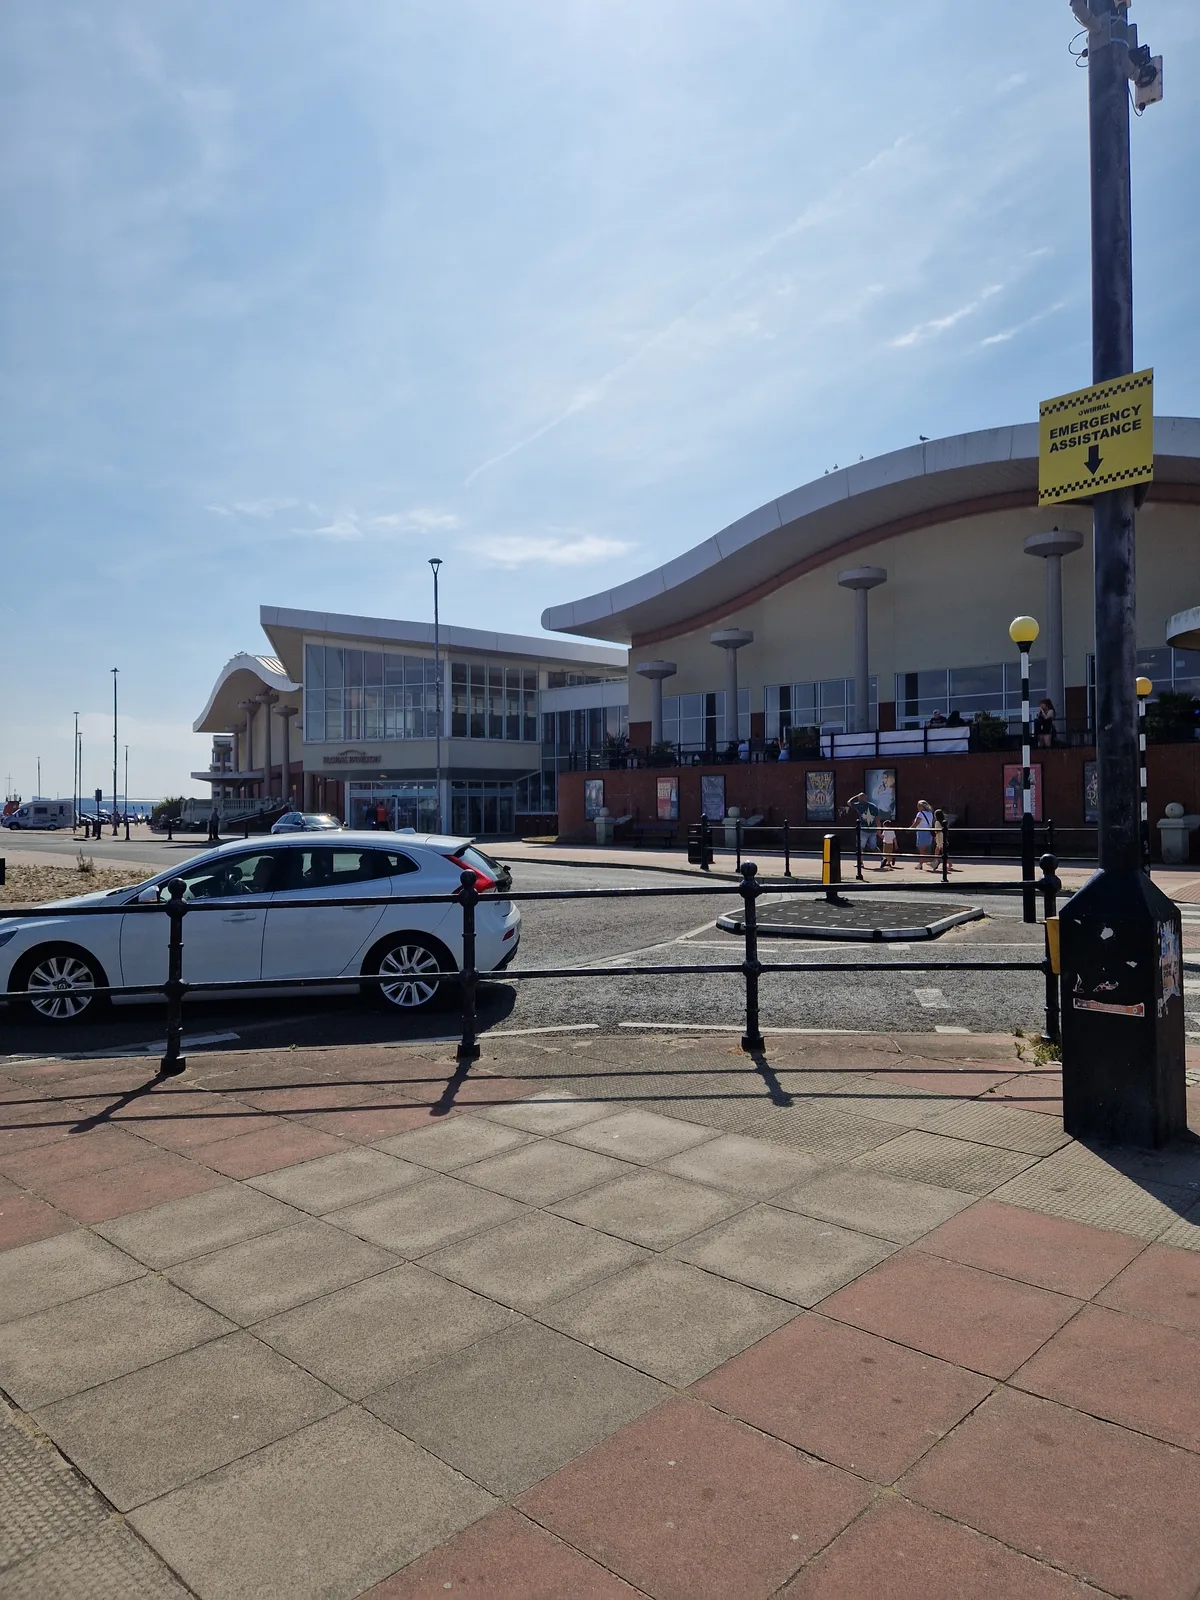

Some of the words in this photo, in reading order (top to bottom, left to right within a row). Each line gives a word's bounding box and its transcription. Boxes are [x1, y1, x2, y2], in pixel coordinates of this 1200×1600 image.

[1049, 404, 1142, 439] EMERGENCY
[1082, 403, 1110, 416] WIRRAL
[1049, 419, 1142, 453] ASSISTANCE
